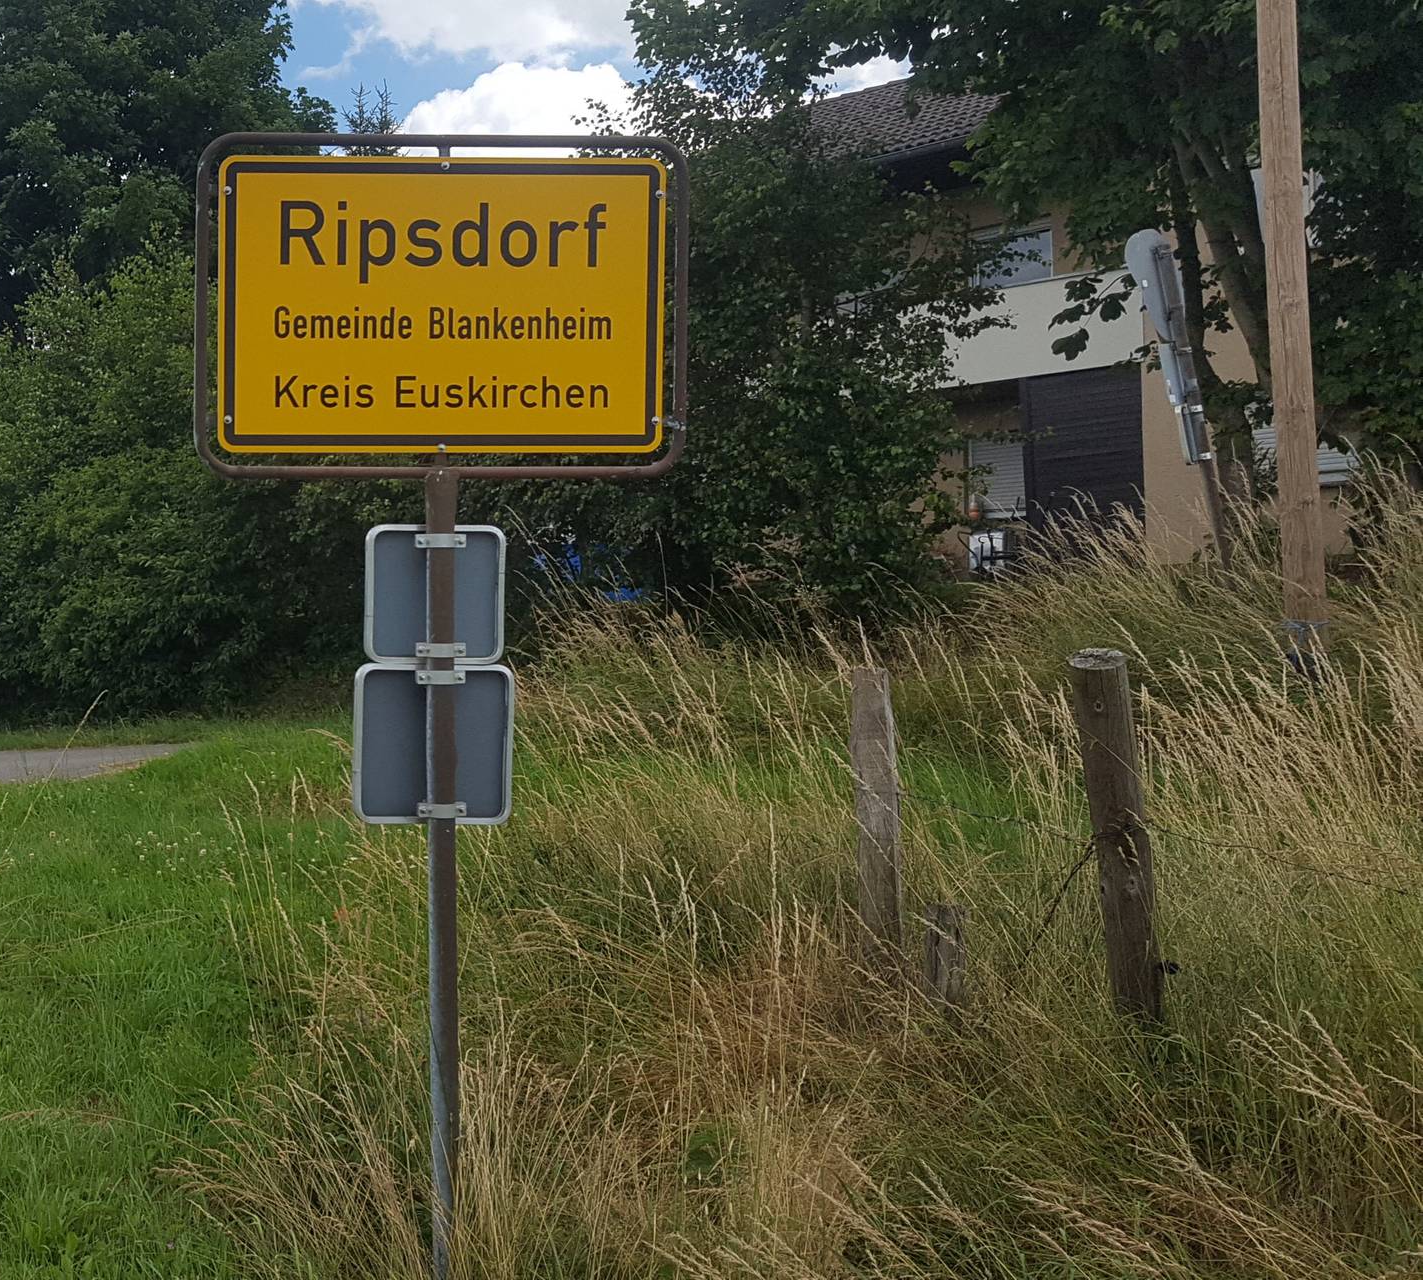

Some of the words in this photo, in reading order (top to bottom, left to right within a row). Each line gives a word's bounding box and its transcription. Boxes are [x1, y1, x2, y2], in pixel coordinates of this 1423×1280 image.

[279, 200, 607, 285] Ripsdorf
[273, 305, 413, 340] Gemeinde
[428, 306, 612, 340] Blankenheim
[274, 375, 375, 409] Kreis
[395, 375, 609, 409] Euskirchen
